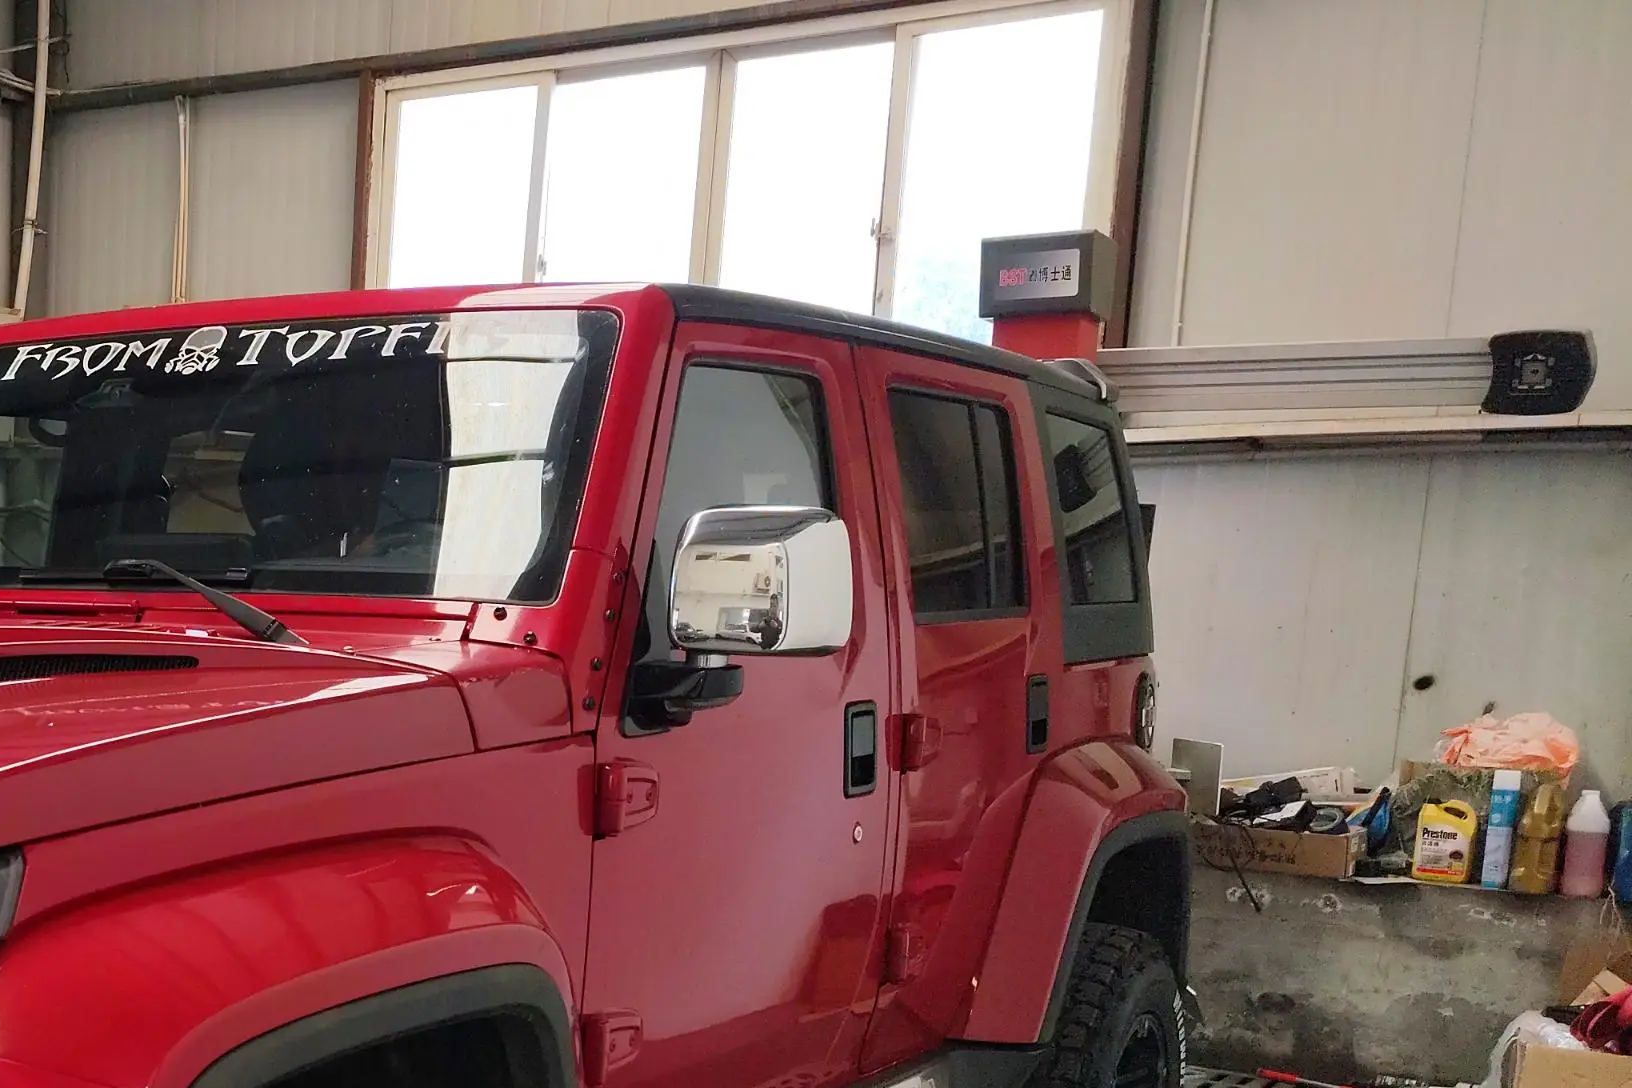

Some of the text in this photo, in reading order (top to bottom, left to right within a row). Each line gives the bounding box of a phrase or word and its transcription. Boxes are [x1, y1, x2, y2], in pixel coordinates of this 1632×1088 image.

[1039, 265, 1072, 283] 博士通
[1422, 827, 1458, 840] Prestone
